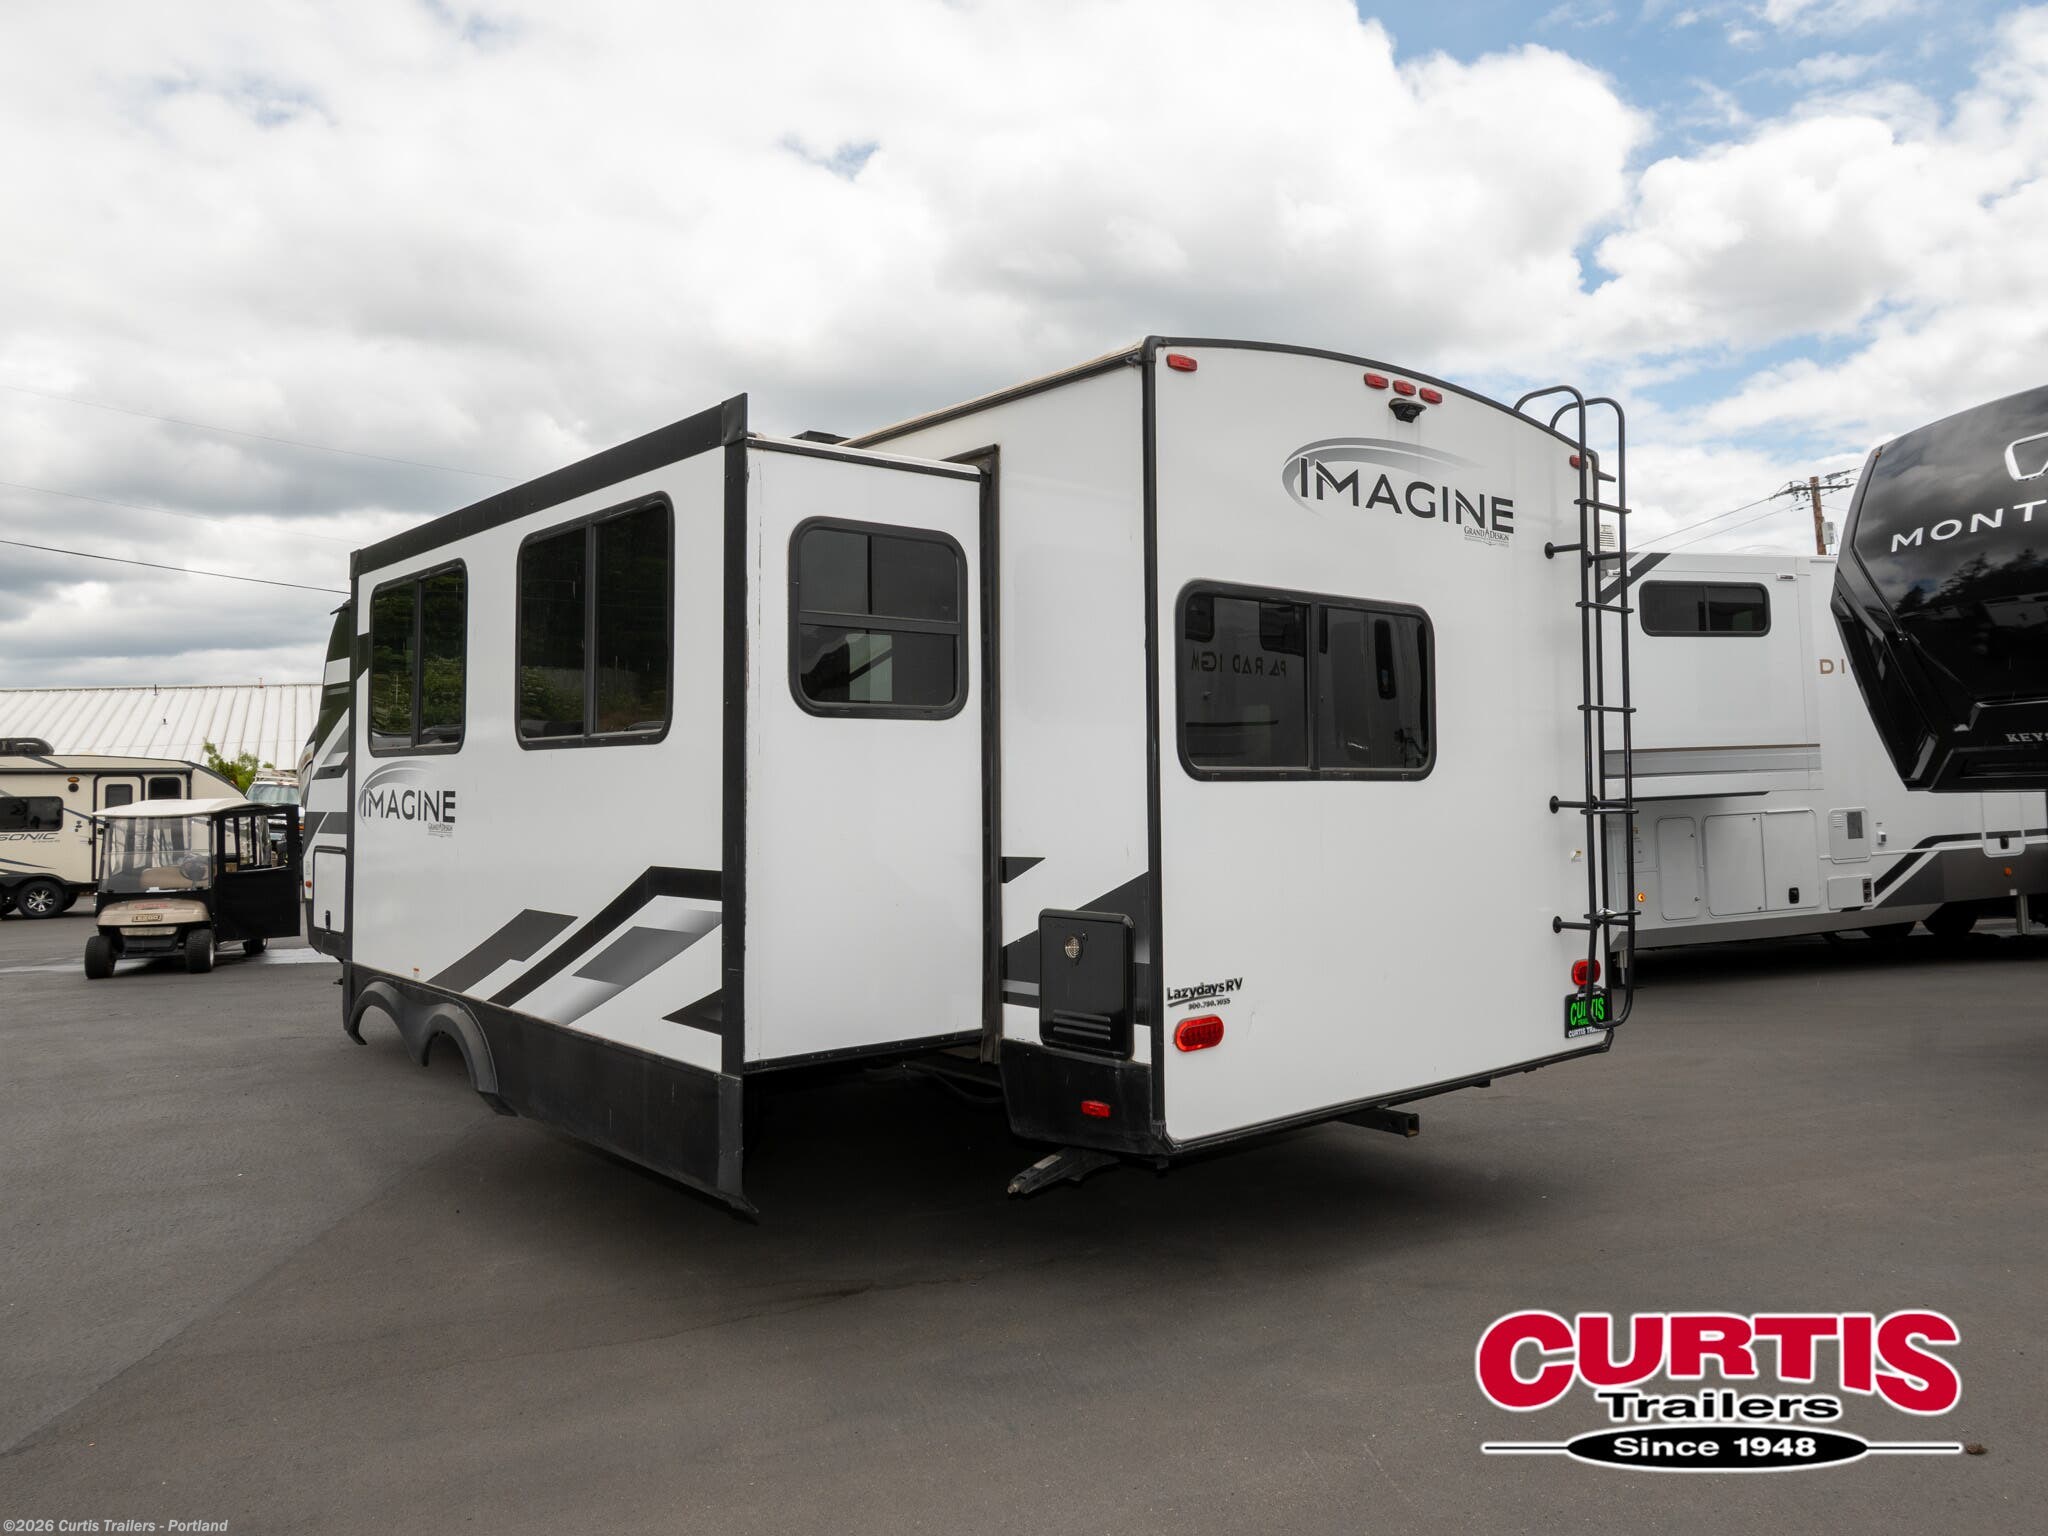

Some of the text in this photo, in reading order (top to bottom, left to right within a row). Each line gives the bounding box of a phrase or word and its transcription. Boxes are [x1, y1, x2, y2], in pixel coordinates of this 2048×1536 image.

[1299, 457, 1515, 534] IMAGINE
[1891, 499, 2048, 553] MONT
[363, 788, 456, 824] IMAGINE
